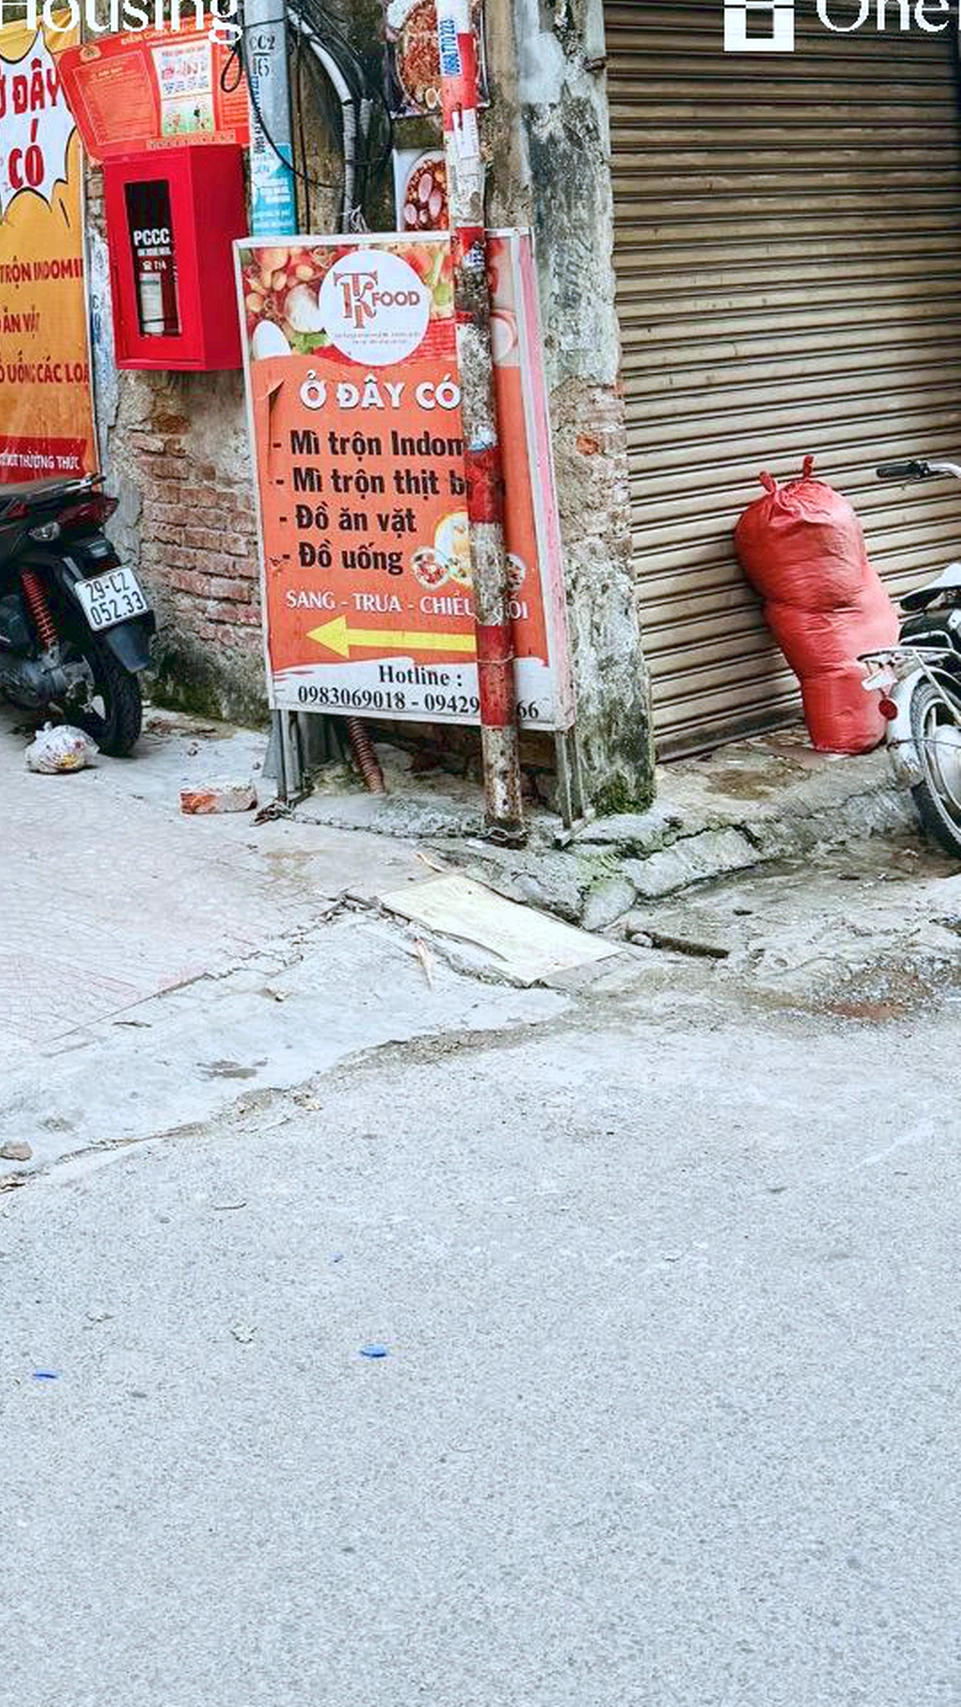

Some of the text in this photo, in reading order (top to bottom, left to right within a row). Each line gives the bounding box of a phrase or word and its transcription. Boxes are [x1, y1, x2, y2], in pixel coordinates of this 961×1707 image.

[13, 58, 61, 115] ĐÂY
[8, 118, 45, 190] CÓ
[133, 228, 171, 247] PCCC
[0, 255, 32, 290] TRỘN
[372, 290, 421, 308] FOOD
[3, 305, 22, 334] ĂN
[37, 354, 62, 384] CÁC
[299, 369, 462, 410] Ở ĐÂY CÓ
[290, 430, 320, 456] Mì
[328, 430, 382, 462] trộn
[293, 467, 323, 493] Mì
[332, 467, 385, 499] trộn
[394, 469, 440, 501] thịt
[296, 501, 329, 531] Đồ
[339, 507, 368, 532] ăn
[378, 507, 417, 539] vặt
[299, 539, 333, 568] Đồ
[342, 542, 404, 575] uống
[89, 591, 145, 626] 052.33
[378, 665, 451, 687] Hotline
[298, 685, 406, 710] 0983069018
